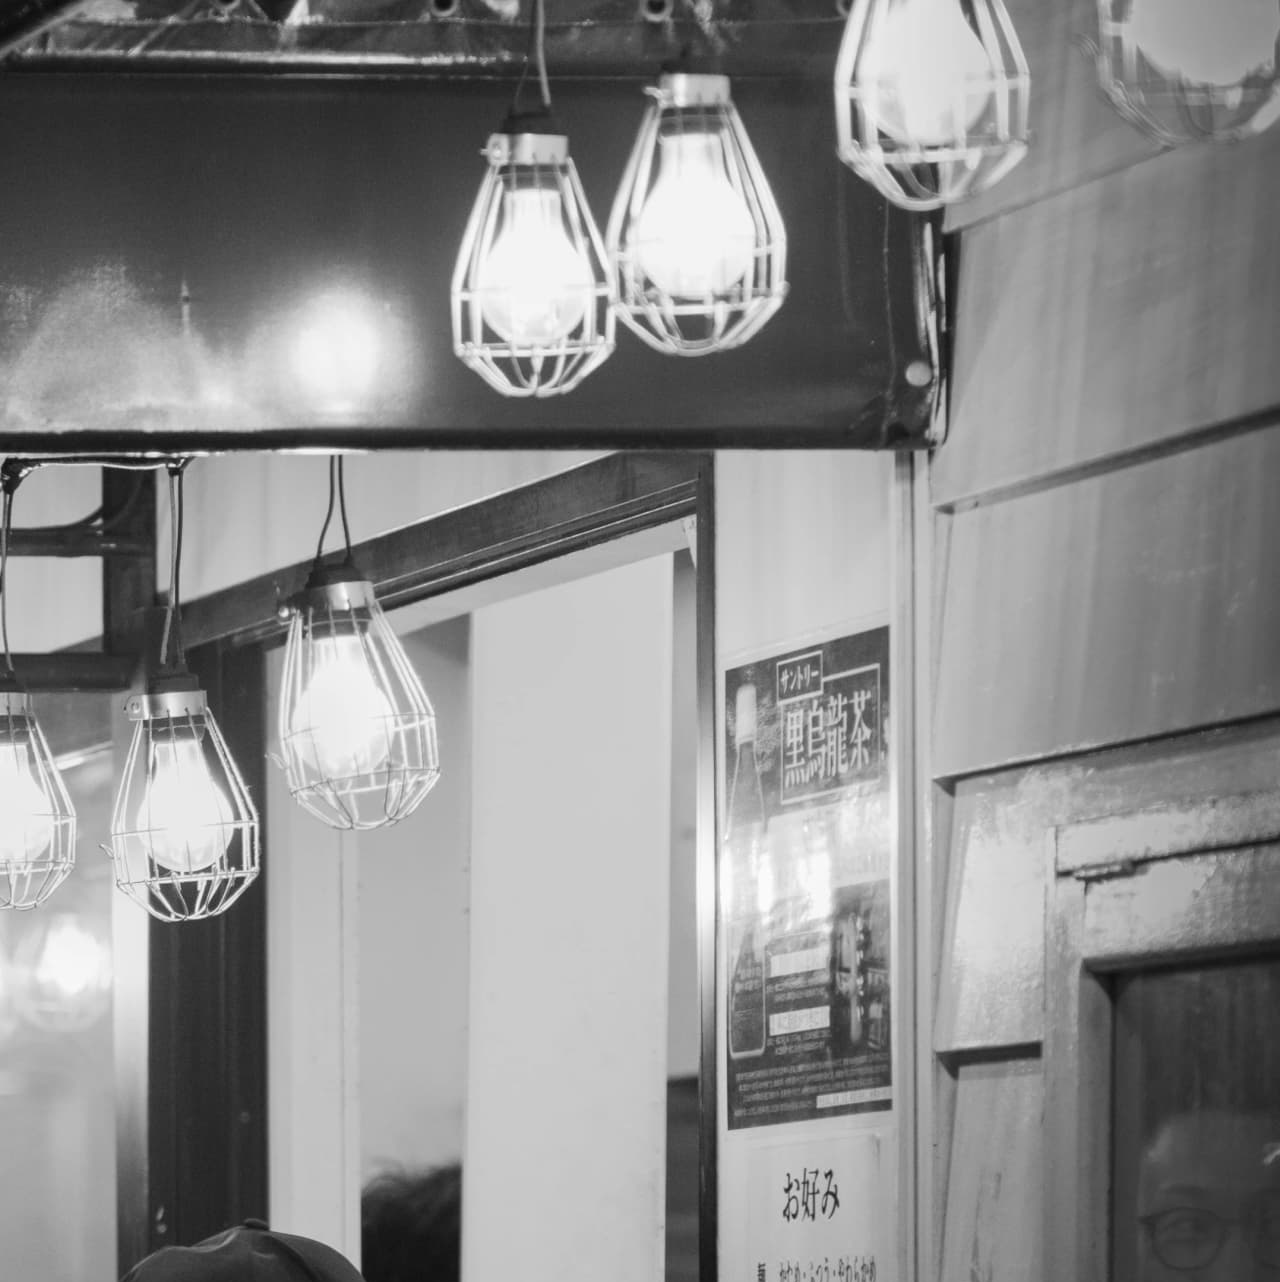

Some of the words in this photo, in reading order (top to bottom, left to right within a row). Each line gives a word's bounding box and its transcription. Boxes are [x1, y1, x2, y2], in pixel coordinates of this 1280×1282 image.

[780, 663, 820, 694] サントリー
[785, 689, 872, 788] 黒烏龍茶
[782, 1167, 840, 1222] お好み
